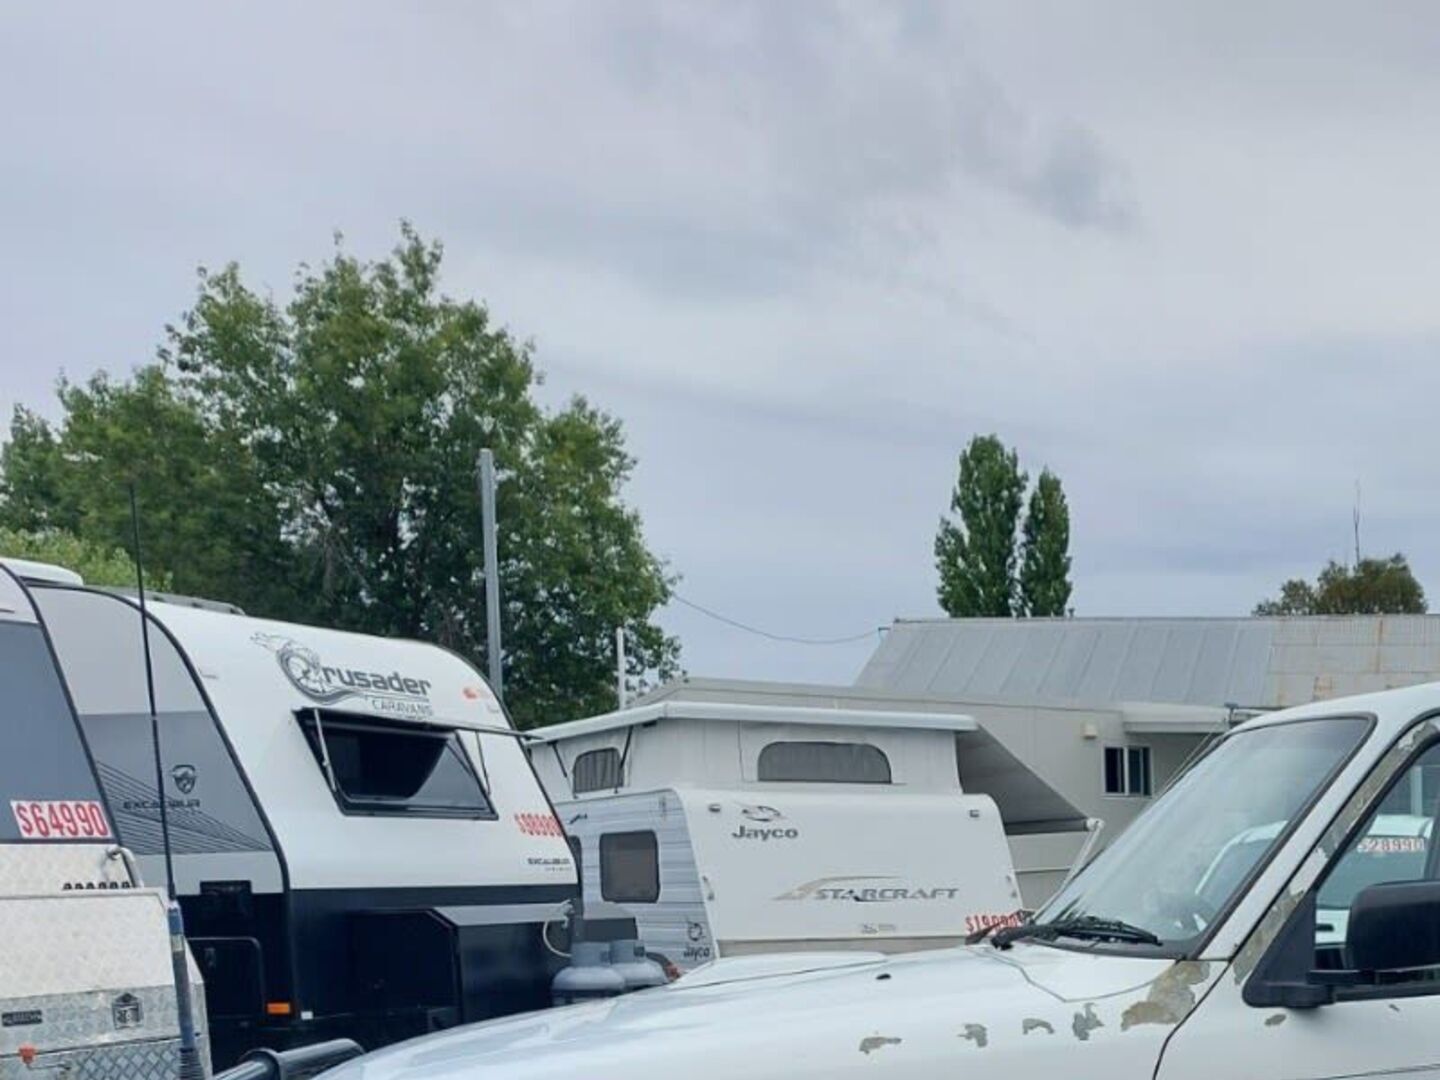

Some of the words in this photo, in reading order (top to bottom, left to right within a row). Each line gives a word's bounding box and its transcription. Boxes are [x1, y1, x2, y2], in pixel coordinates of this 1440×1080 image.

[16, 803, 109, 837] $64990
[732, 825, 798, 841] Jayco
[816, 888, 959, 901] STARCRAFT
